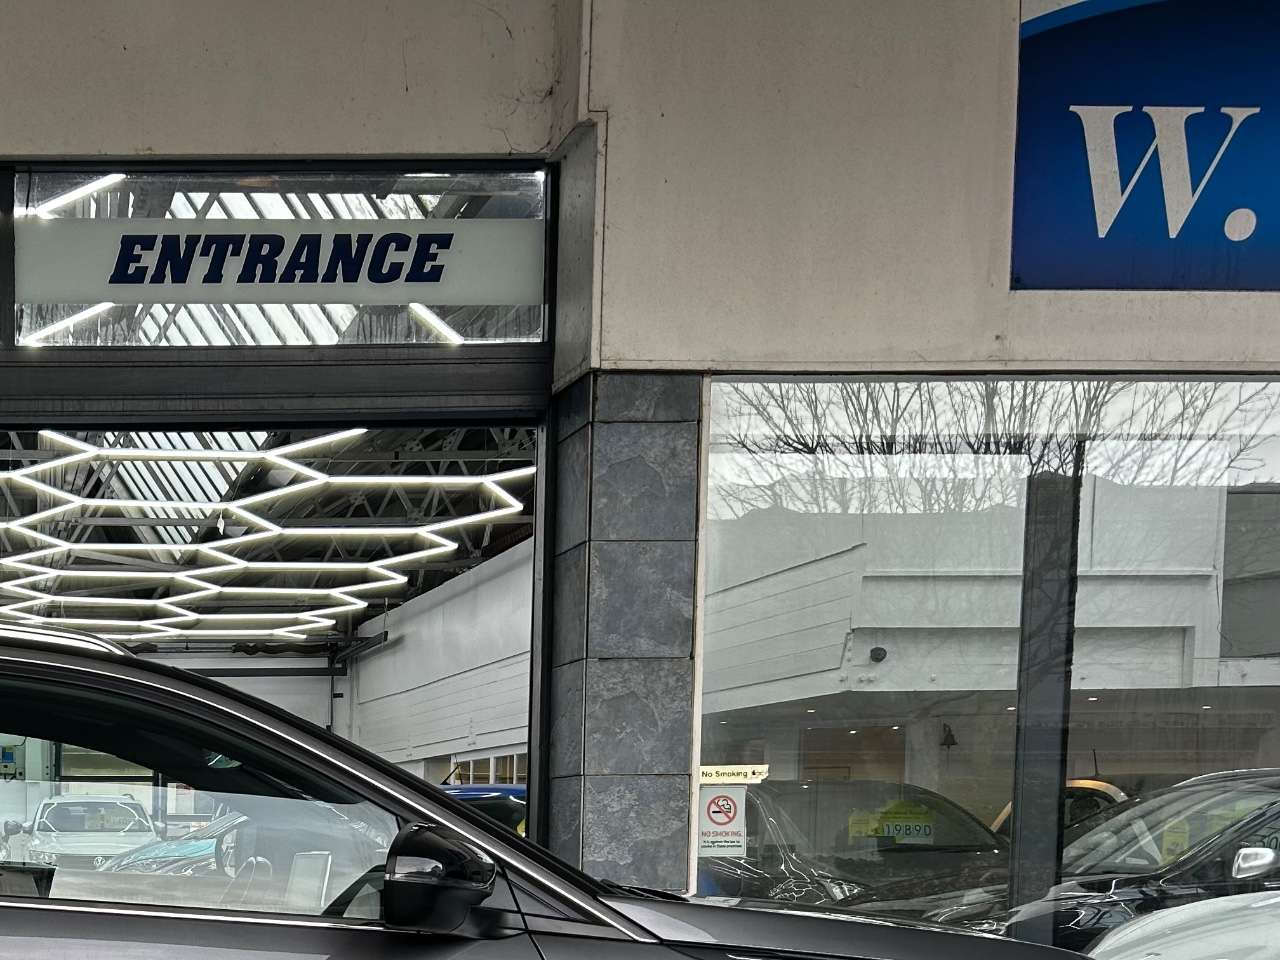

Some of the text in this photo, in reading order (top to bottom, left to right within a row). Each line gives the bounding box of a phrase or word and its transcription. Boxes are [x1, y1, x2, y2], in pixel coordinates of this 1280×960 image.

[1069, 105, 1261, 241] W.
[109, 232, 454, 284] ENTRANCE
[715, 770, 748, 778] Smoking
